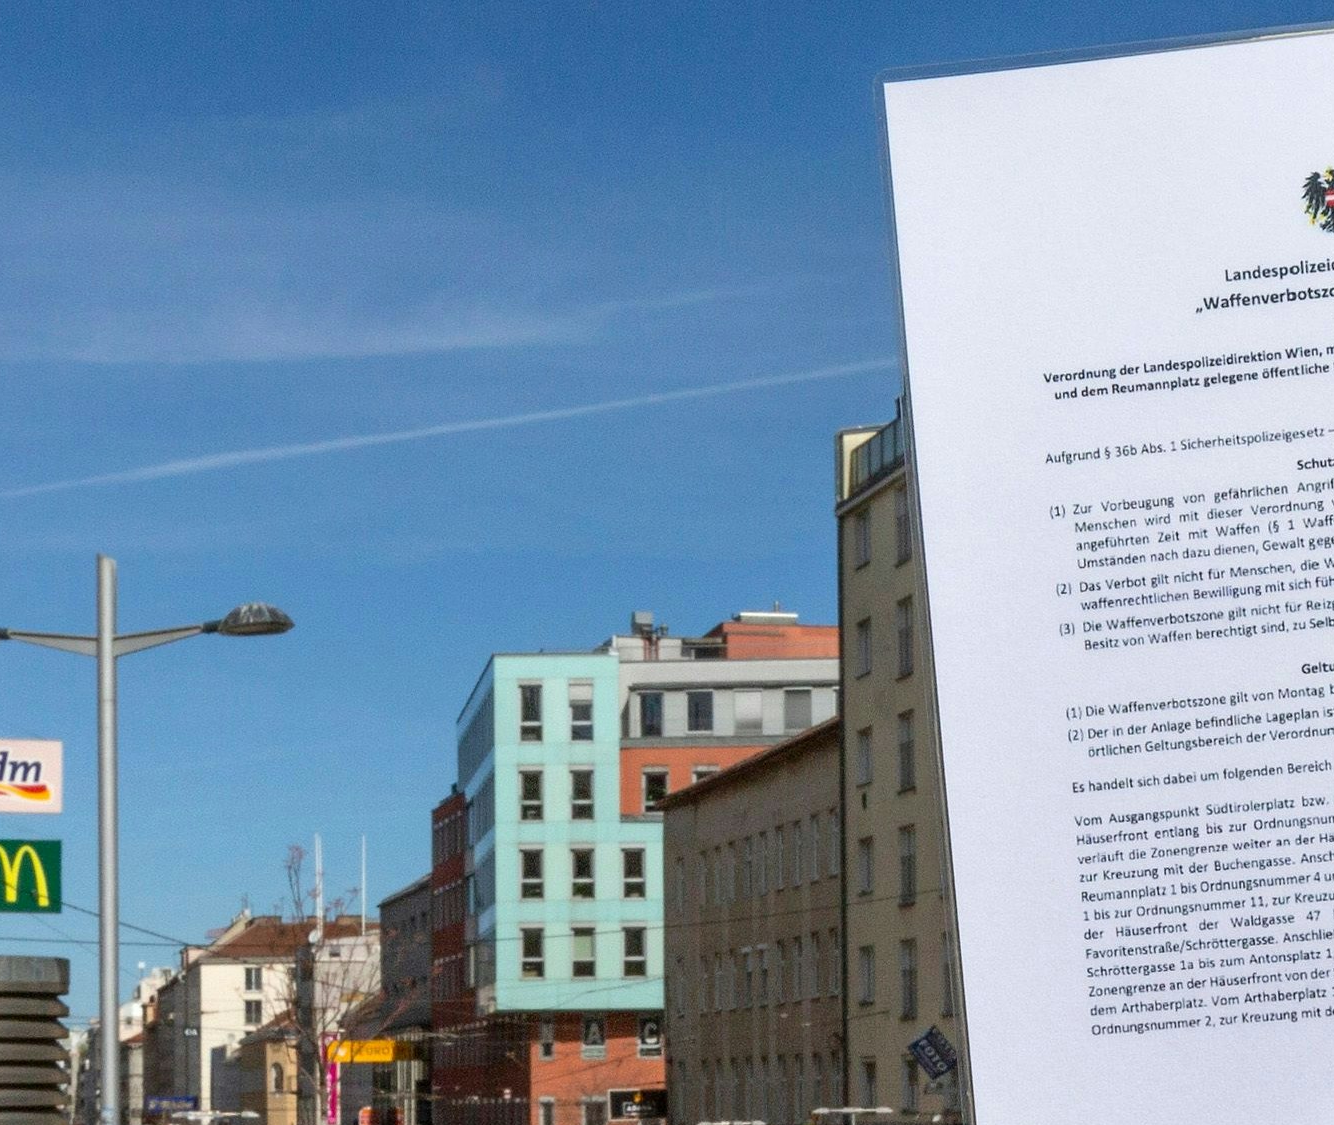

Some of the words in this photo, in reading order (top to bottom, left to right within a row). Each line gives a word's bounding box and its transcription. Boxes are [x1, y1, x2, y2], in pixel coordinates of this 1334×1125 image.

[1042, 367, 1117, 383] Verordnung
[1119, 364, 1140, 376] der
[1143, 349, 1282, 374] Landespolizeidirektion
[1284, 346, 1323, 360] Wien,
[1054, 386, 1078, 400] und
[1080, 385, 1109, 398] dem
[1111, 375, 1200, 394] Reumannplatz
[1203, 371, 1258, 388] gelegene
[1261, 362, 1330, 379] öffentliche
[1044, 447, 1101, 465] Aufgrund
[1114, 444, 1138, 458] 36b
[1140, 442, 1166, 455] Abs.
[1179, 427, 1324, 451] Sicherheitspolizeigesetz
[1049, 504, 1066, 520] (1)
[1072, 503, 1092, 515] Zur
[1100, 496, 1175, 512] Vorbeugung
[1182, 493, 1206, 504] von
[1090, 1018, 1201, 1036] Ordnungsnummer
[1218, 1015, 1238, 1026] zur
[1240, 1010, 1298, 1023] Kreuzung
[1300, 1007, 1322, 1019] mit
